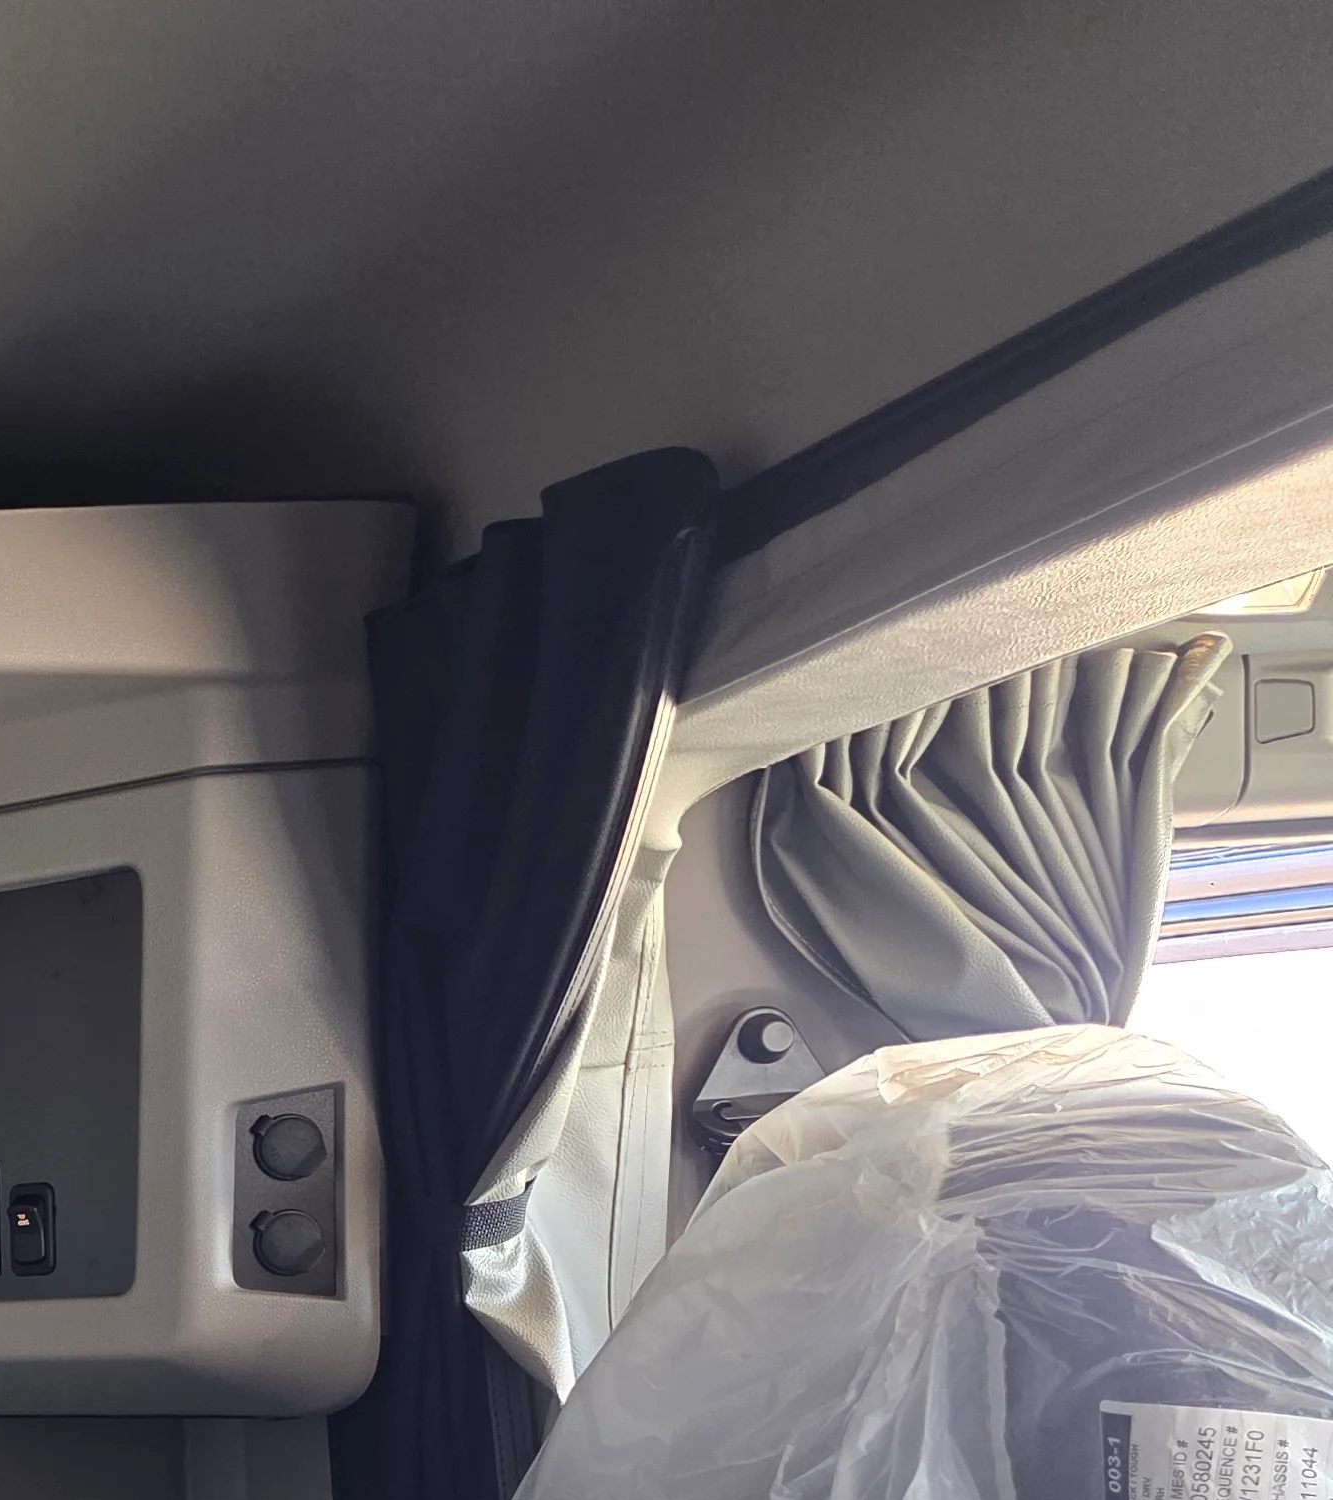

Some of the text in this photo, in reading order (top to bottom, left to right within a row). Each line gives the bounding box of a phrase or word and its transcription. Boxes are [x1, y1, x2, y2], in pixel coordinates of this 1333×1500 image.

[1107, 1436, 1122, 1493] 003-1
[1173, 1452, 1188, 1466] ID
[1170, 1470, 1185, 1500] MES
